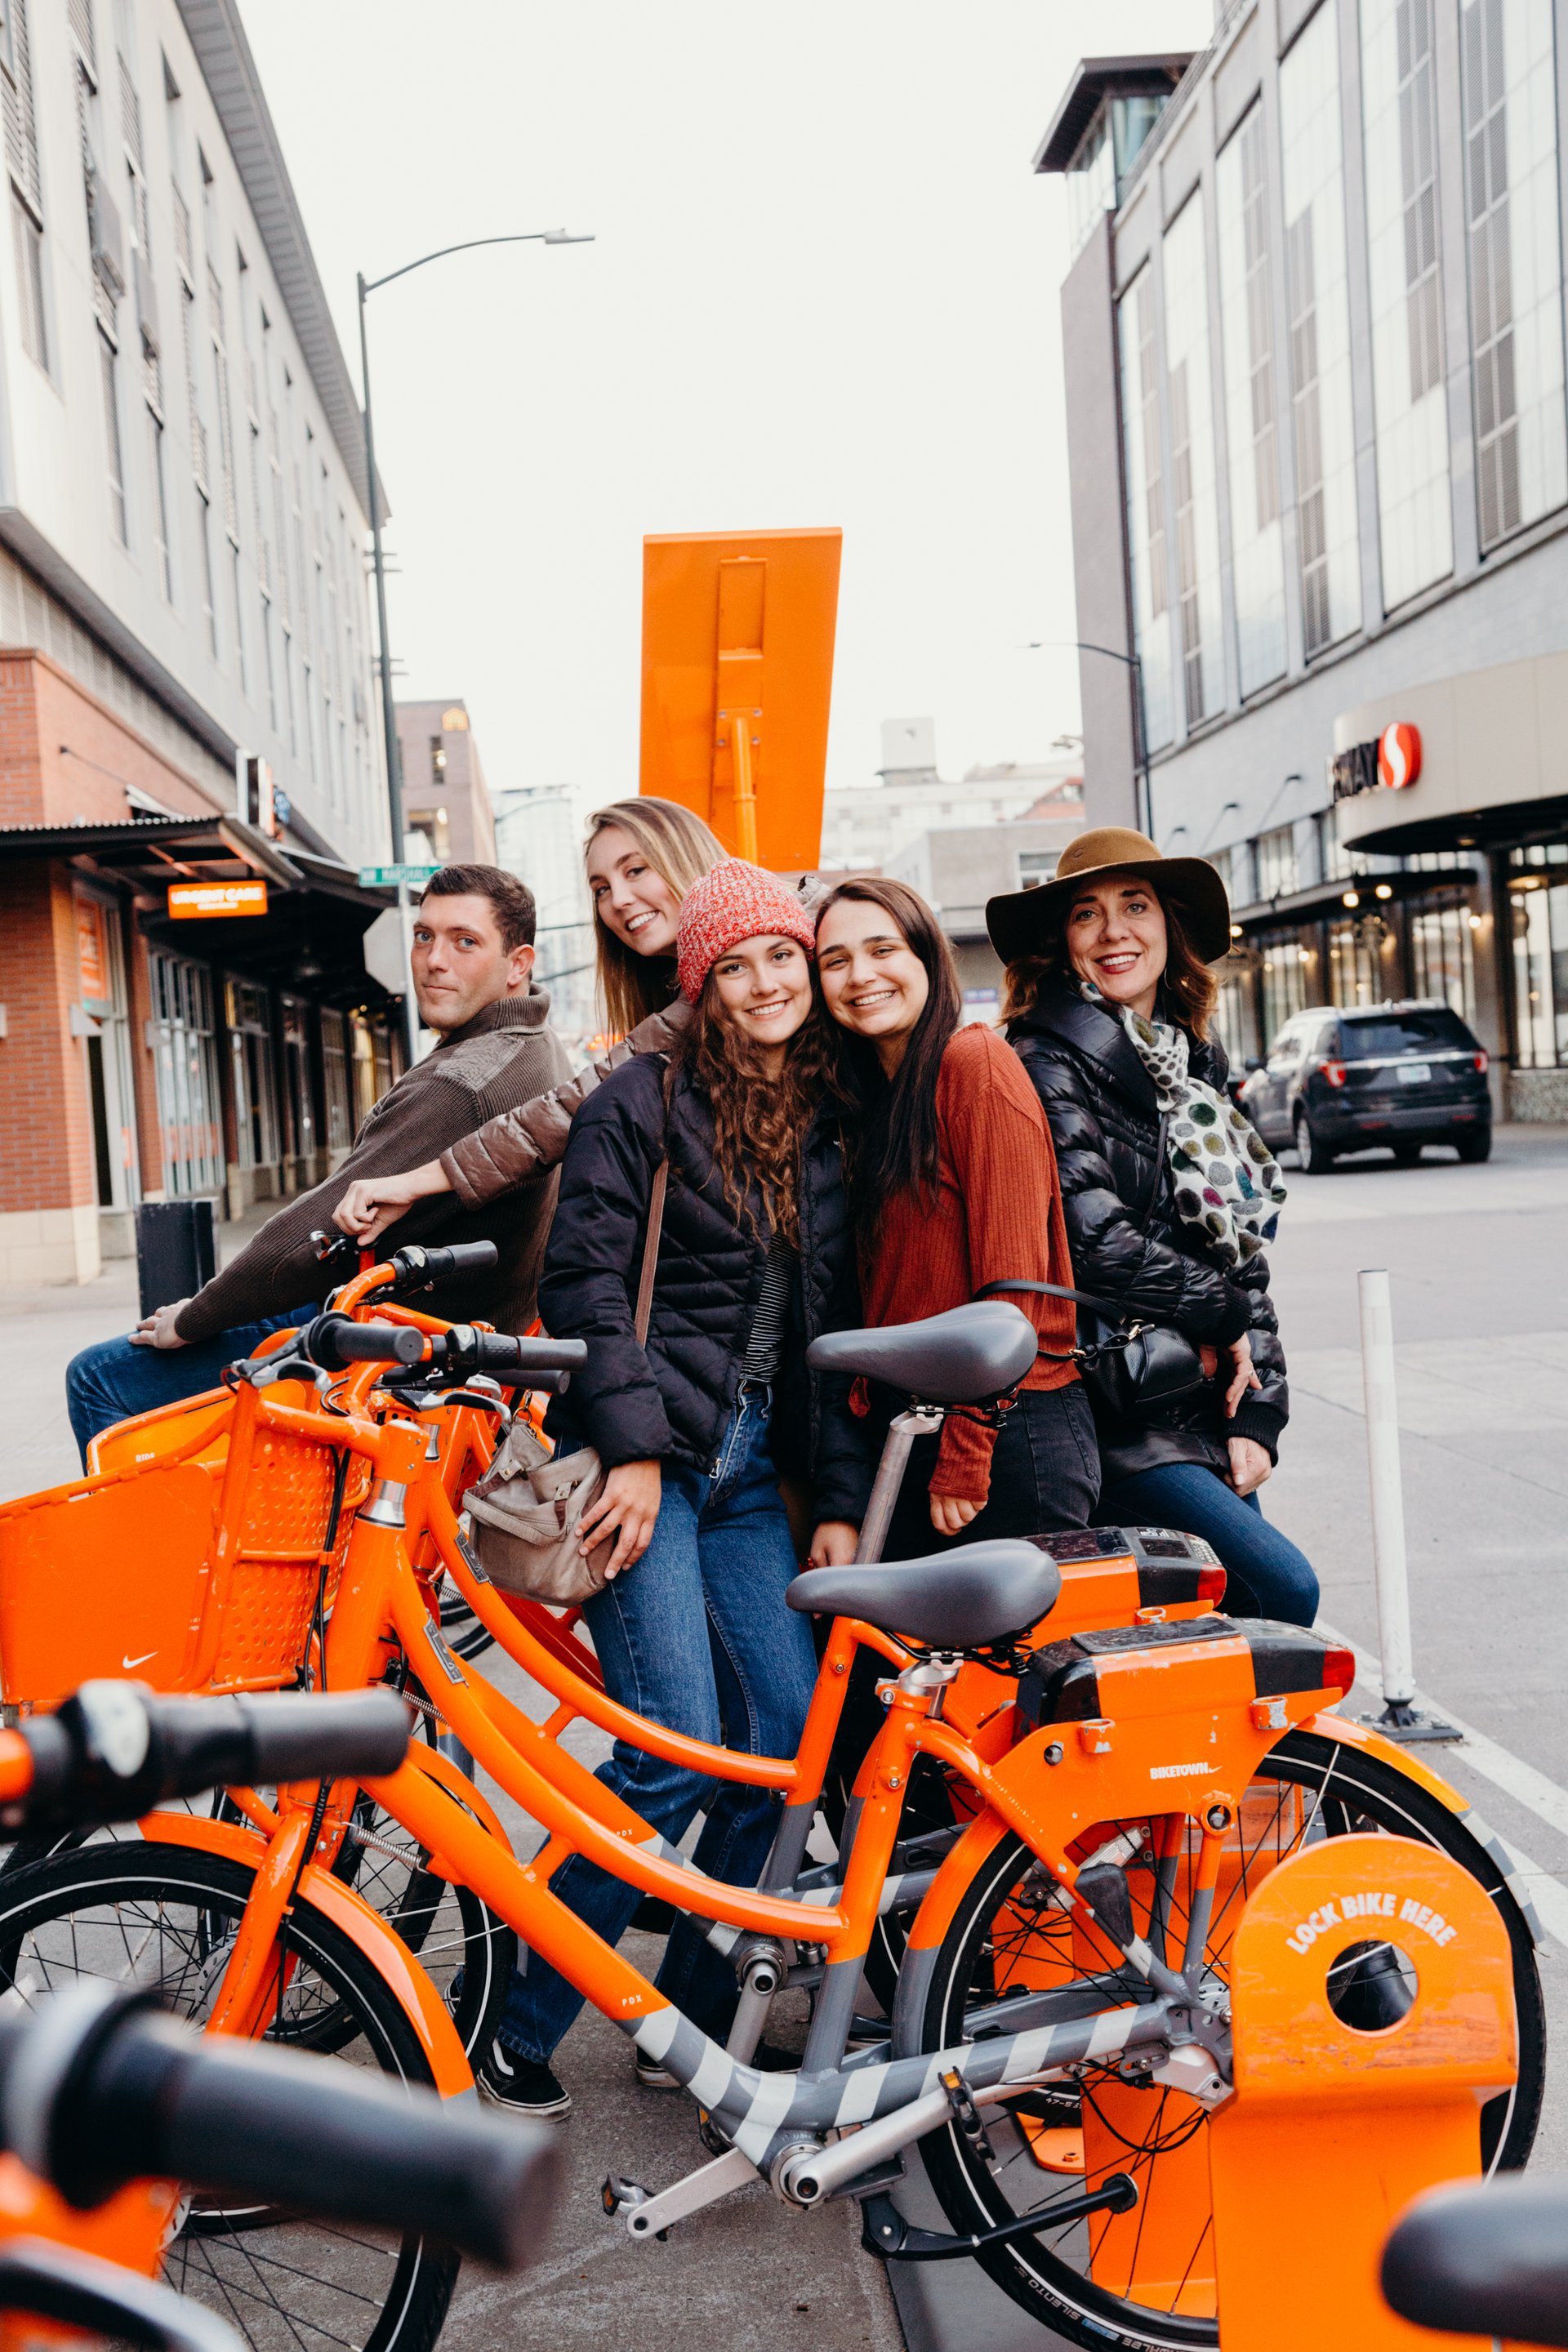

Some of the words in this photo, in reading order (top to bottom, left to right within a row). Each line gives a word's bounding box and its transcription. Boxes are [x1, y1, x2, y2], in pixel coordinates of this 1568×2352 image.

[225, 887, 263, 902] CARE
[1150, 1762, 1208, 1780] BIKETOWN
[1285, 1902, 1343, 1954] LOCK
[1340, 1892, 1396, 1919] BIKE
[1399, 1898, 1457, 1947] HERE
[621, 1994, 642, 2007] PDX
[1028, 2279, 1081, 2320] SILENTO
